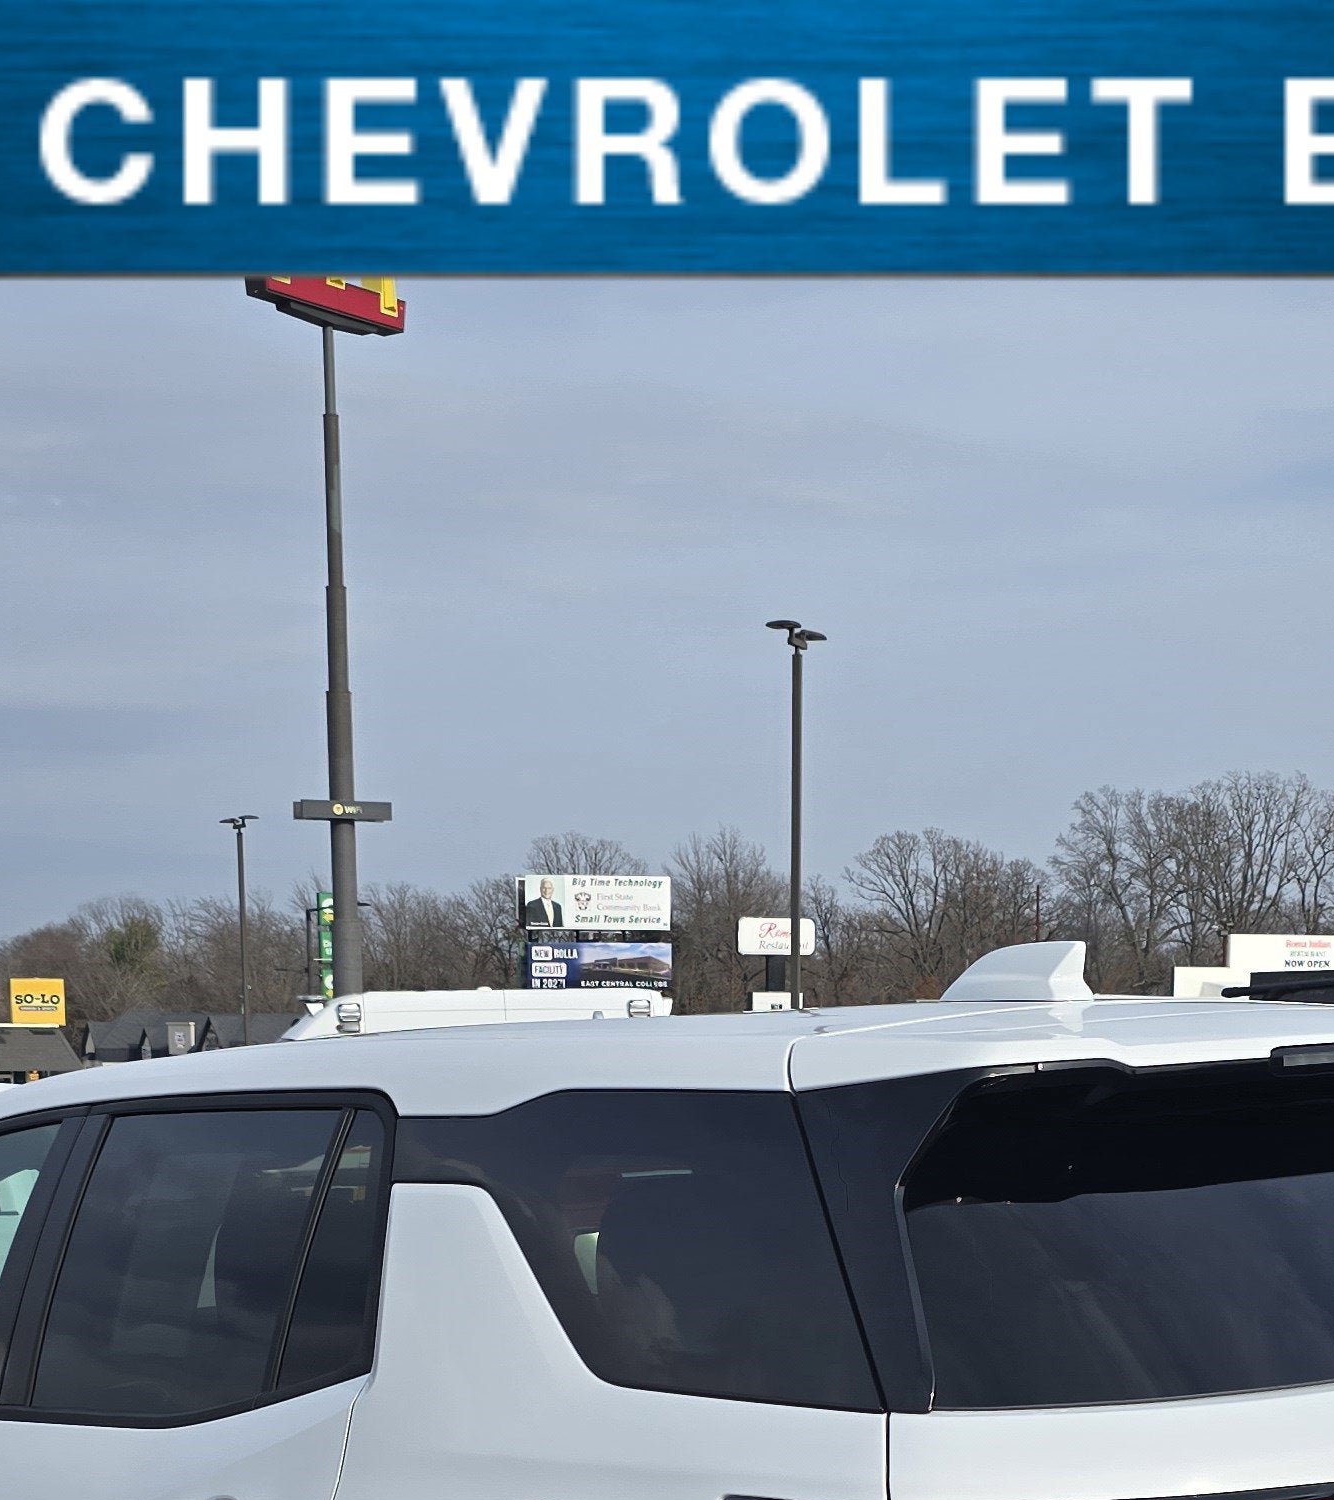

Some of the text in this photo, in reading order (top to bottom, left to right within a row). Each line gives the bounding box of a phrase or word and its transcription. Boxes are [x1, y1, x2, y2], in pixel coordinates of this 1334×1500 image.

[572, 878, 663, 888] Big Time Technology
[575, 915, 661, 923] Small Town Service
[535, 948, 578, 959] NEW ROLLA
[1284, 960, 1330, 968] NOW OPEN
[534, 965, 563, 974] FACILITY
[14, 993, 60, 1005] SO-LO
